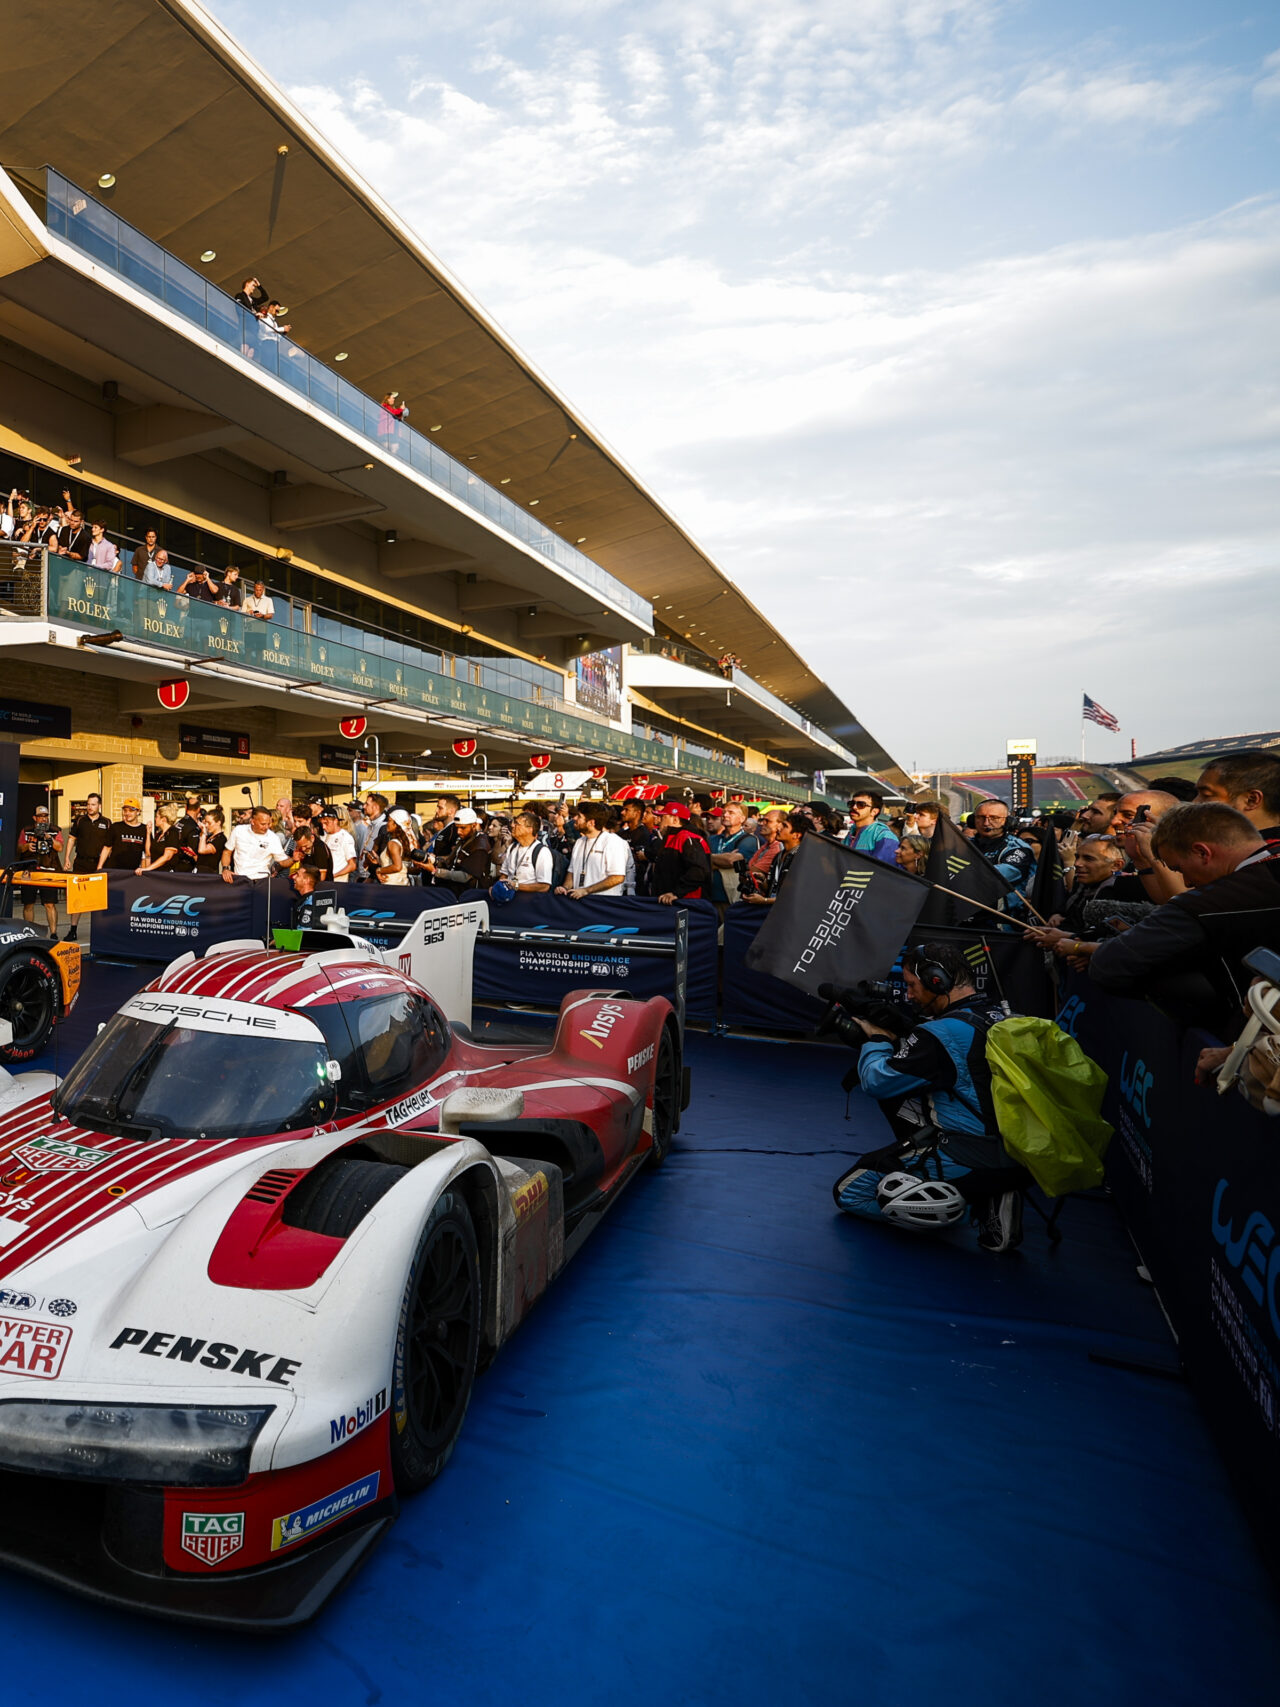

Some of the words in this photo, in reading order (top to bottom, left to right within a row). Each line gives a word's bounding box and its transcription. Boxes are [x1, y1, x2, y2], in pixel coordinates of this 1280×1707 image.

[67, 596, 112, 621] ROLEX
[143, 617, 181, 639] ROLEX
[207, 634, 240, 654] ROLEX
[262, 649, 291, 667] ROLEX
[310, 661, 335, 678] ROLEX
[352, 673, 374, 689] ROLEX
[170, 683, 177, 703] 1
[389, 683, 409, 697] ROLEX
[421, 692, 439, 705] ROLEX
[451, 699, 467, 711] ROLEX
[477, 707, 491, 718] ROLEX
[349, 719, 358, 734] 2
[500, 713, 514, 724] ROLEX
[461, 740, 469, 753] 3
[536, 755, 544, 766] 4
[553, 773, 564, 789] 8
[130, 895, 206, 916] WEC
[130, 922, 175, 930] CHAMPIONSHIP
[175, 926, 187, 935] FIA
[424, 911, 477, 933] PORSCHE
[424, 932, 445, 946] 963
[520, 950, 535, 958] FIA
[572, 954, 631, 964] ENDURANCE
[520, 957, 590, 968] CHAMPIONSHIP
[30, 957, 53, 979] EAGLE
[528, 966, 589, 975] PARTNERSHIP
[591, 964, 610, 976] FIA
[127, 999, 278, 1031] PORSCHE
[579, 1003, 625, 1049] Ansys
[627, 1043, 655, 1075] PENSKE
[18, 1146, 91, 1171] HEUER
[41, 1140, 102, 1162] TAG
[108, 1327, 302, 1386] PENSKE
[330, 1399, 373, 1444] Mobil
[305, 1484, 370, 1528] MICHELIN
[188, 1516, 239, 1533] TAG
[185, 1536, 241, 1563] HEUER
